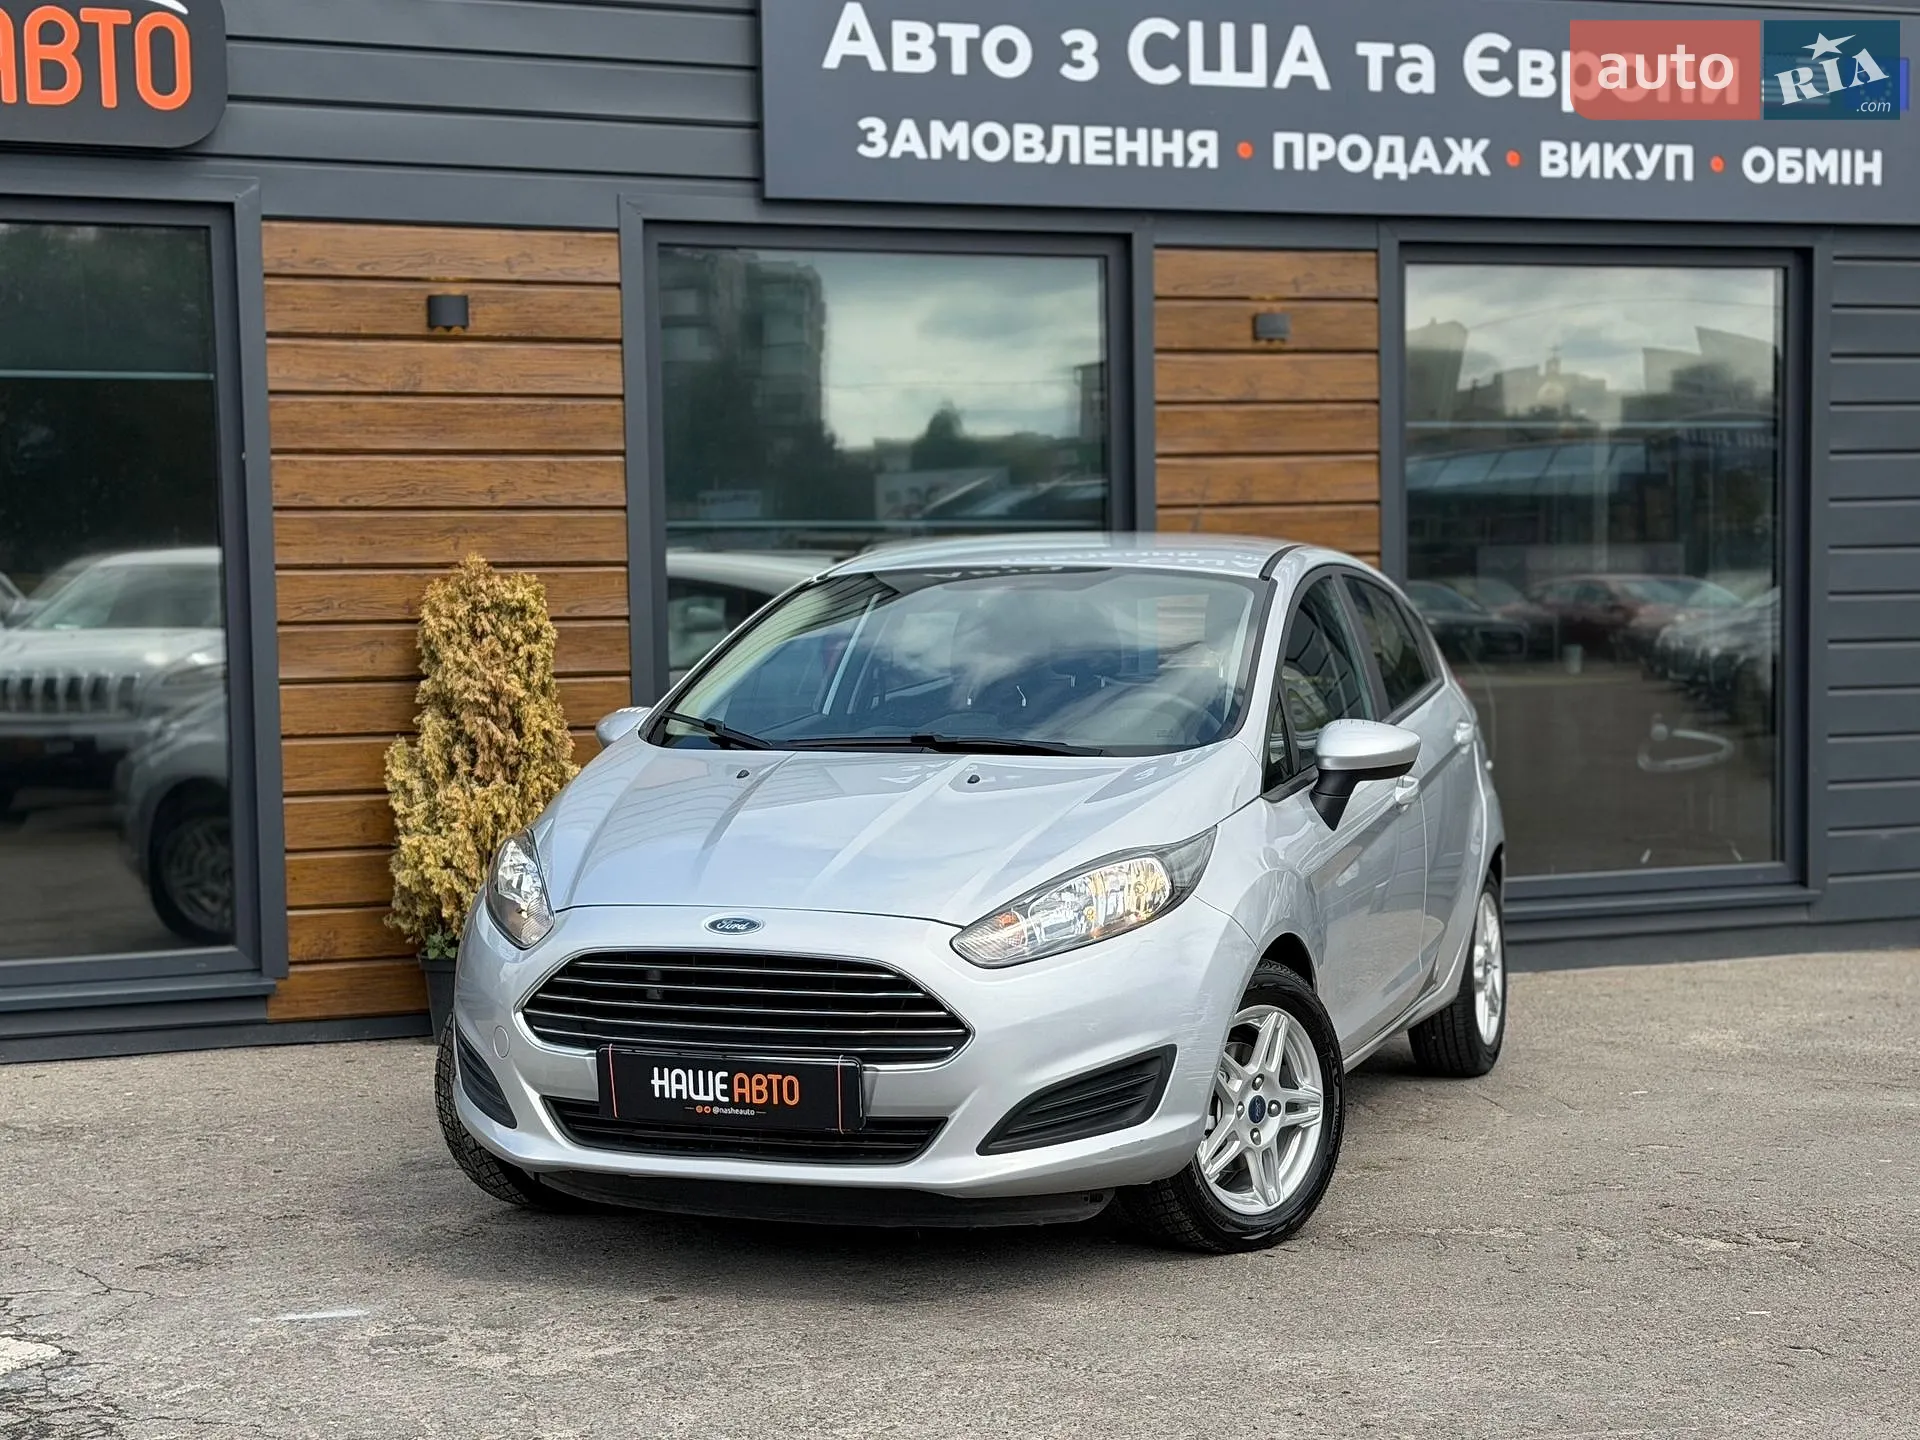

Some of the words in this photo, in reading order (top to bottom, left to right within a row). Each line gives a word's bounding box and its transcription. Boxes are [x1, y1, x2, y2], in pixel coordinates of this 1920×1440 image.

[1127, 17, 1331, 90] США
[1355, 41, 1436, 94] та
[856, 116, 1219, 169] ЗАМОВЛЕННЯ
[1273, 131, 1491, 181] ПРОДАЖ
[1540, 142, 1694, 181] ВИКУП
[1742, 147, 1883, 186] ОБМІН
[716, 919, 750, 930] Ford
